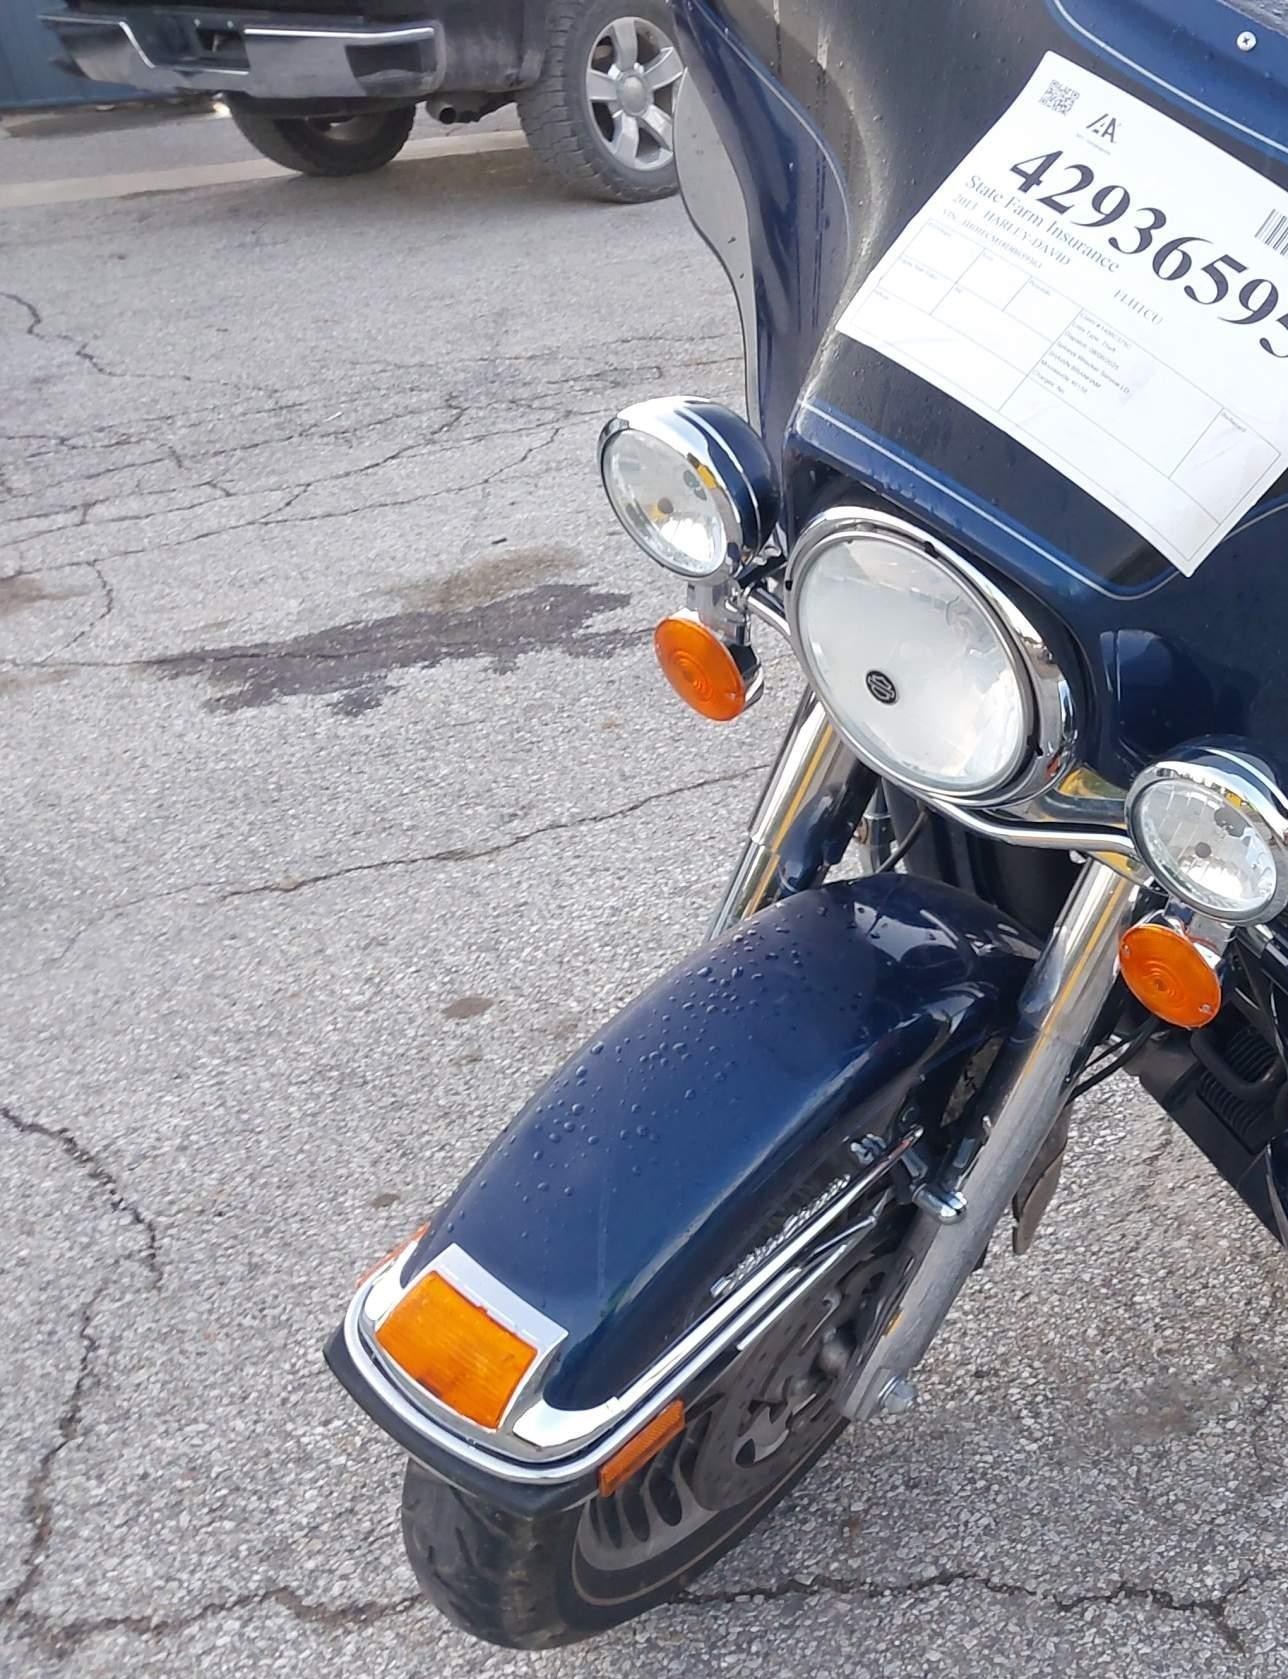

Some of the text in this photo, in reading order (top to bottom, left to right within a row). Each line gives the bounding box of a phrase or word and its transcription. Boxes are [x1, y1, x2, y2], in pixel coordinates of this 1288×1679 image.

[965, 174, 1004, 204] State
[1004, 196, 1044, 228] Farm
[1046, 220, 1120, 272] Insurance
